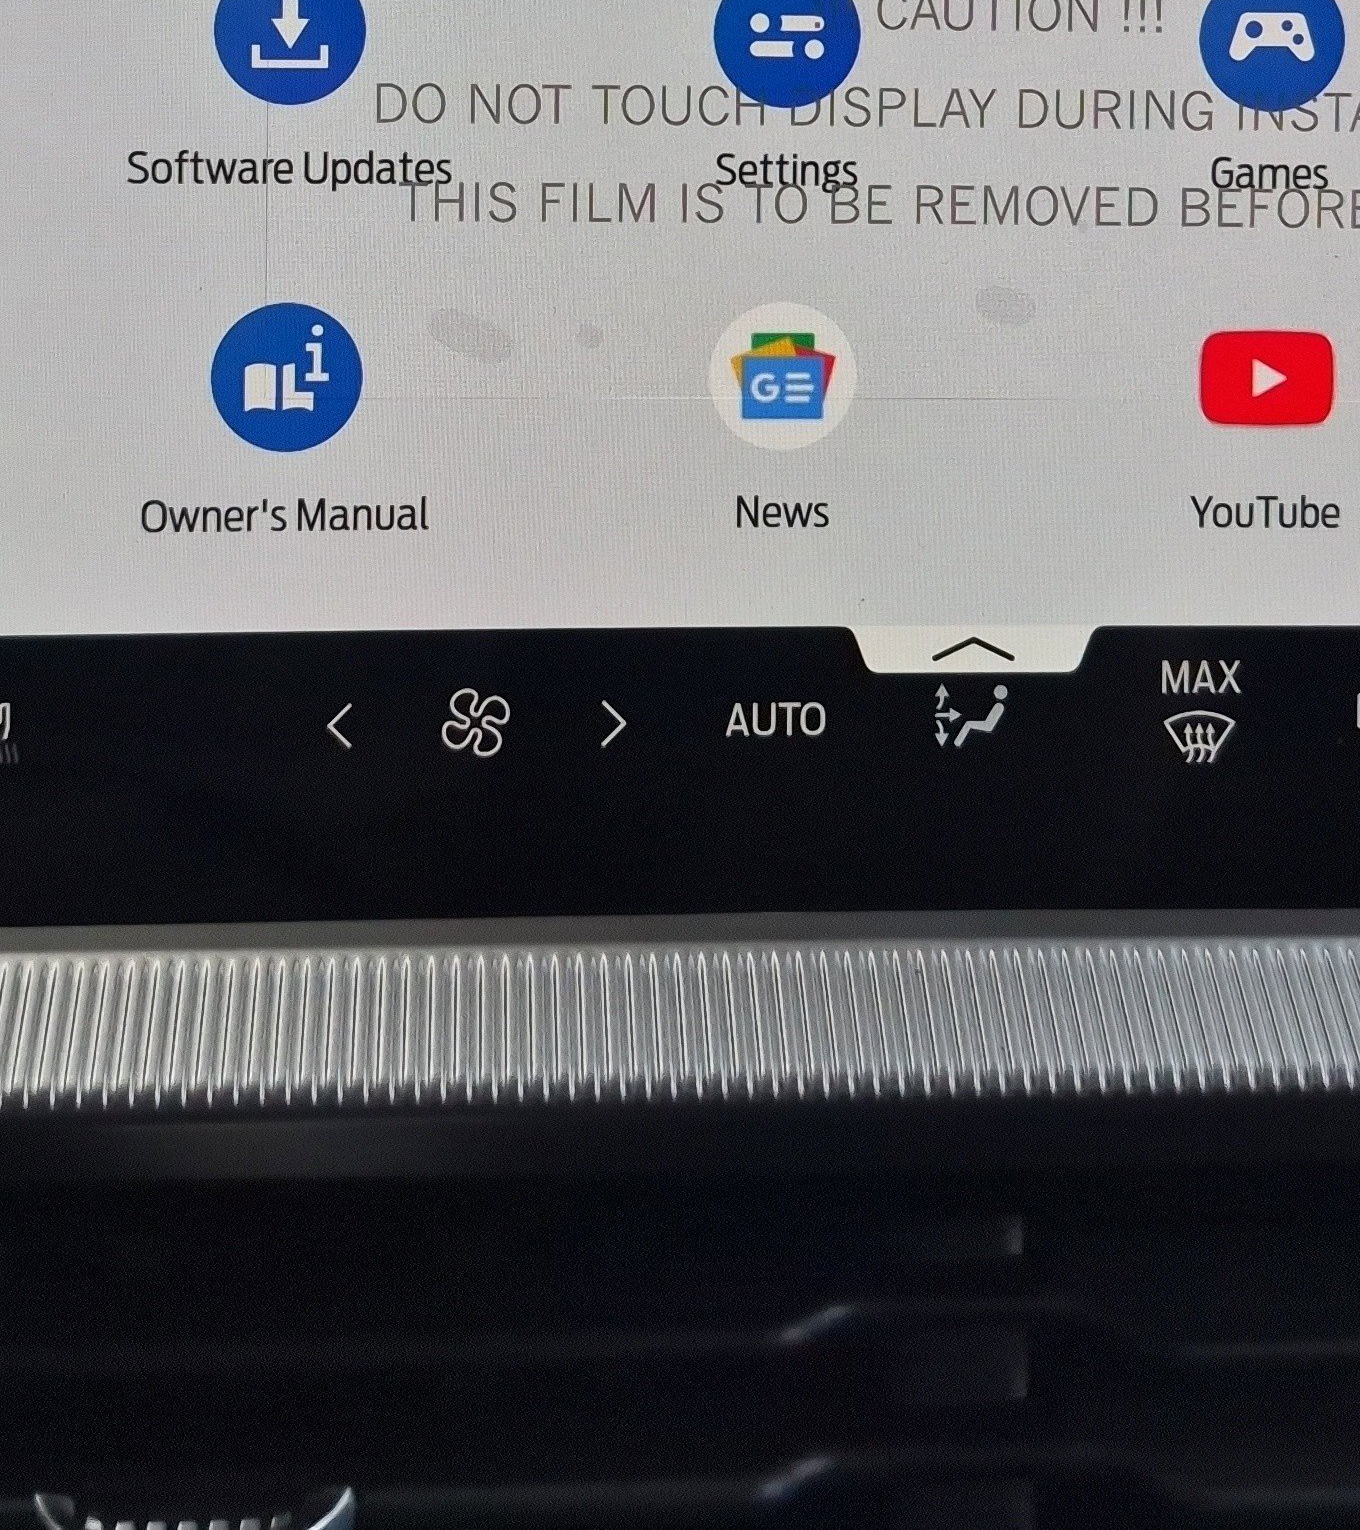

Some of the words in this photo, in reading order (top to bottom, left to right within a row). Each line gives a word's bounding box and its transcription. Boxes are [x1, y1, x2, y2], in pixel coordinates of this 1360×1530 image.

[377, 83, 446, 124] DO
[471, 84, 572, 125] NOT
[592, 85, 765, 127] TOUCH
[791, 87, 996, 129] DISPLAY
[1018, 89, 1215, 131] DURING
[127, 149, 293, 184] Software
[304, 151, 452, 191] Updates
[716, 153, 859, 192] Settings
[1211, 157, 1329, 190] Games
[399, 182, 517, 224] THIS
[542, 183, 655, 222] FILM
[681, 183, 725, 224] IS
[746, 184, 808, 225] TO
[829, 184, 893, 225] BE
[916, 185, 1158, 226] REMOVED
[141, 498, 287, 533] Owner's
[297, 496, 429, 531] Manual
[736, 495, 829, 528] News
[1190, 495, 1340, 528] YouTube
[1162, 661, 1240, 693] MAX
[726, 703, 825, 736] AUTO
